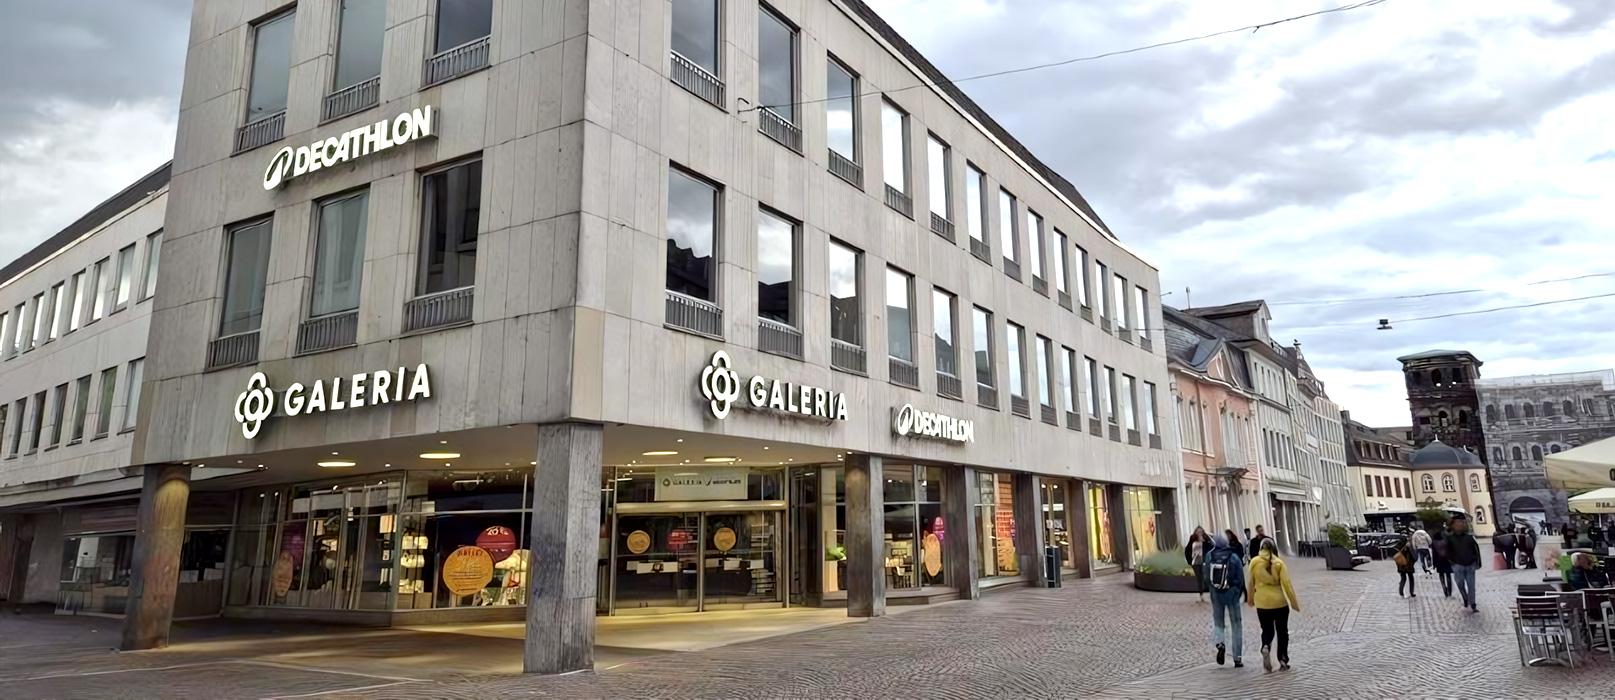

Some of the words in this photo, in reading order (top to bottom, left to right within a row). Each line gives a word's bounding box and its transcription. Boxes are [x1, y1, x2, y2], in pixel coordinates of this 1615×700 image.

[293, 105, 431, 177] DECATHLON
[284, 363, 431, 416] GALERIA
[749, 375, 849, 421] GALERIA
[914, 408, 974, 443] DECATHLON
